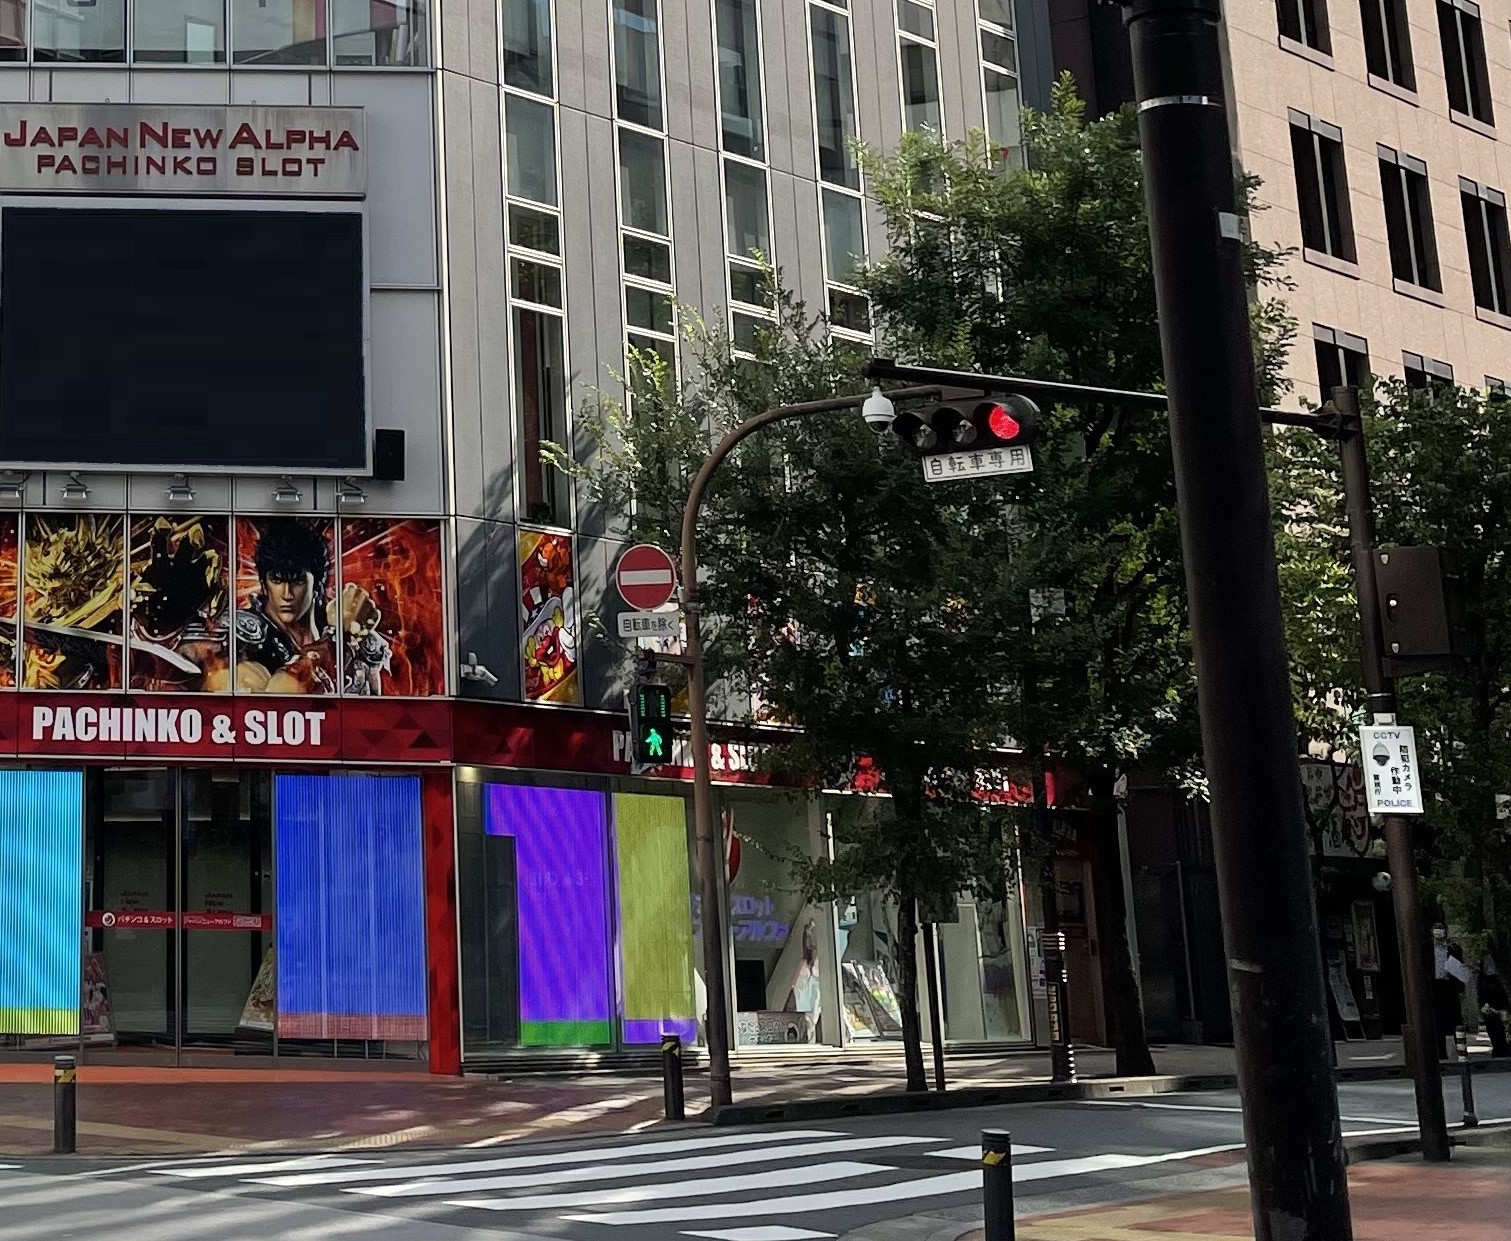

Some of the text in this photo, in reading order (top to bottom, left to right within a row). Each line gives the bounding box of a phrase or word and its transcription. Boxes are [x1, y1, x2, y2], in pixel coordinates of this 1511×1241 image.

[4, 120, 359, 151] JAPAN NEW ALPHA
[37, 154, 326, 177] PACHINKO SLOT
[930, 448, 1025, 476] 自転車専用
[623, 618, 675, 633] 自転車を除く
[32, 706, 326, 746] PACHINKO & SLOT
